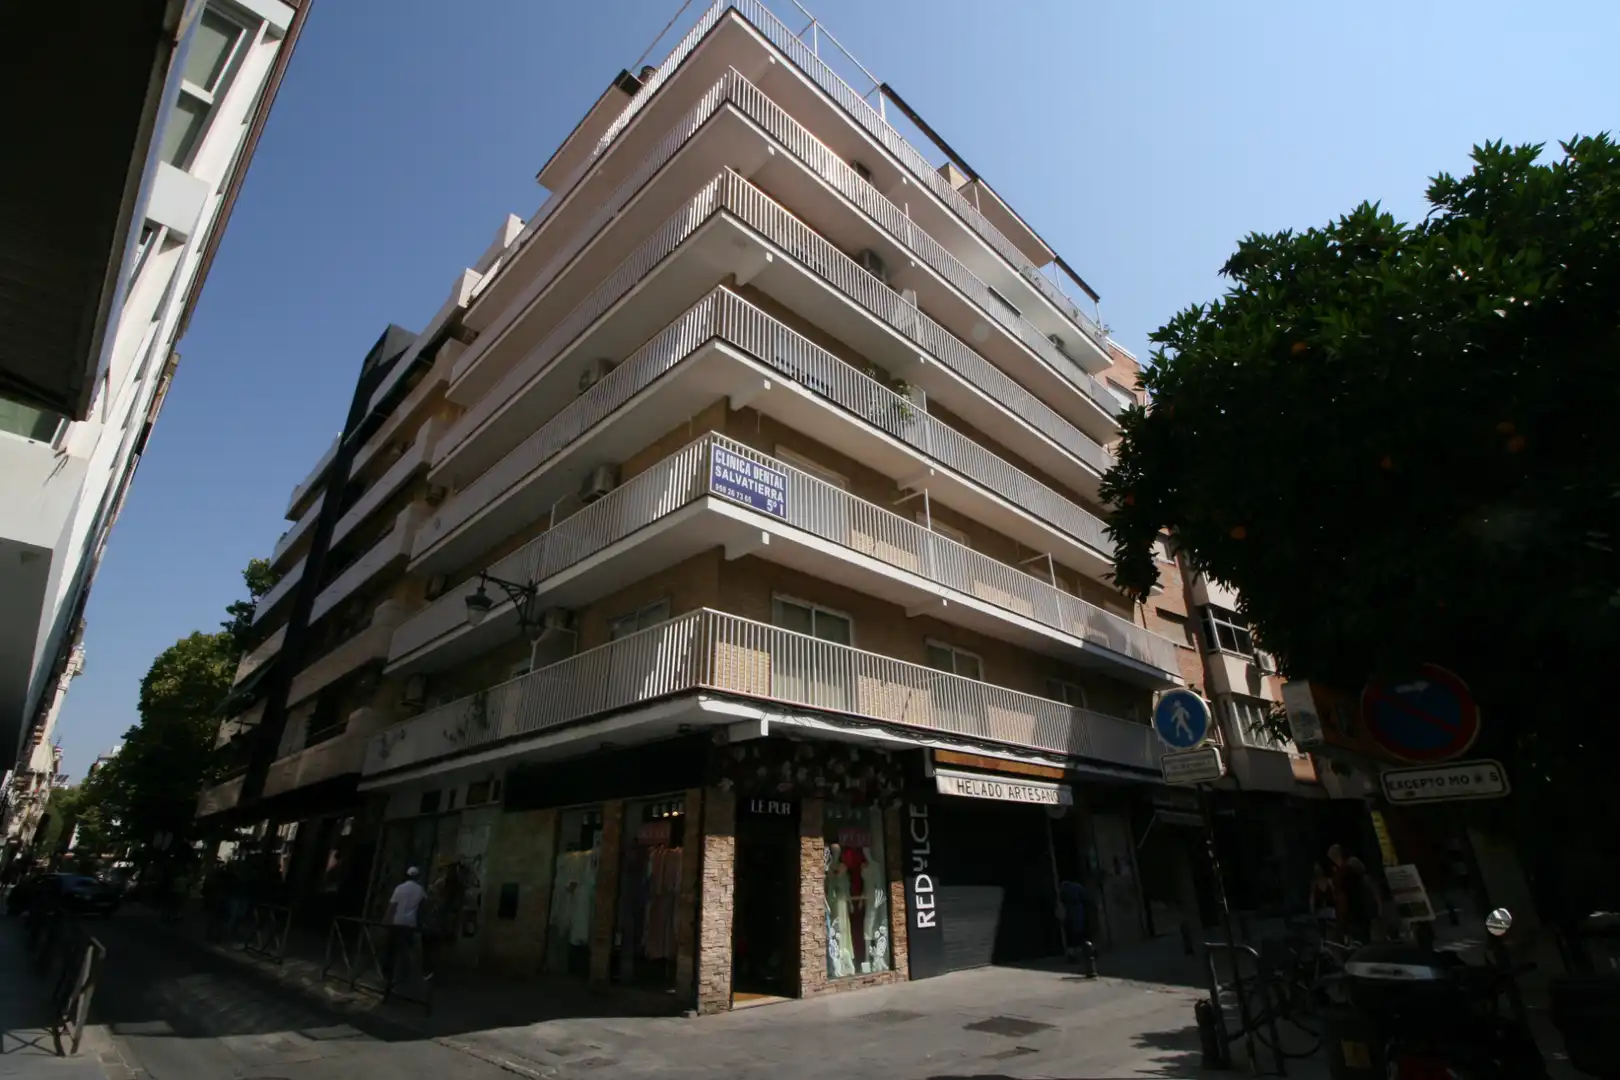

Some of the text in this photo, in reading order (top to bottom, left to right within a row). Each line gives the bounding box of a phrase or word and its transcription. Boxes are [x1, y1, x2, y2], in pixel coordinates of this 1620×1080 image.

[715, 449, 785, 491] CLINICA DENTAL
[715, 465, 785, 503] SALVATIERRA
[956, 779, 1061, 803] HELADO ARTESANO
[1387, 776, 1445, 790] EXCEPTO
